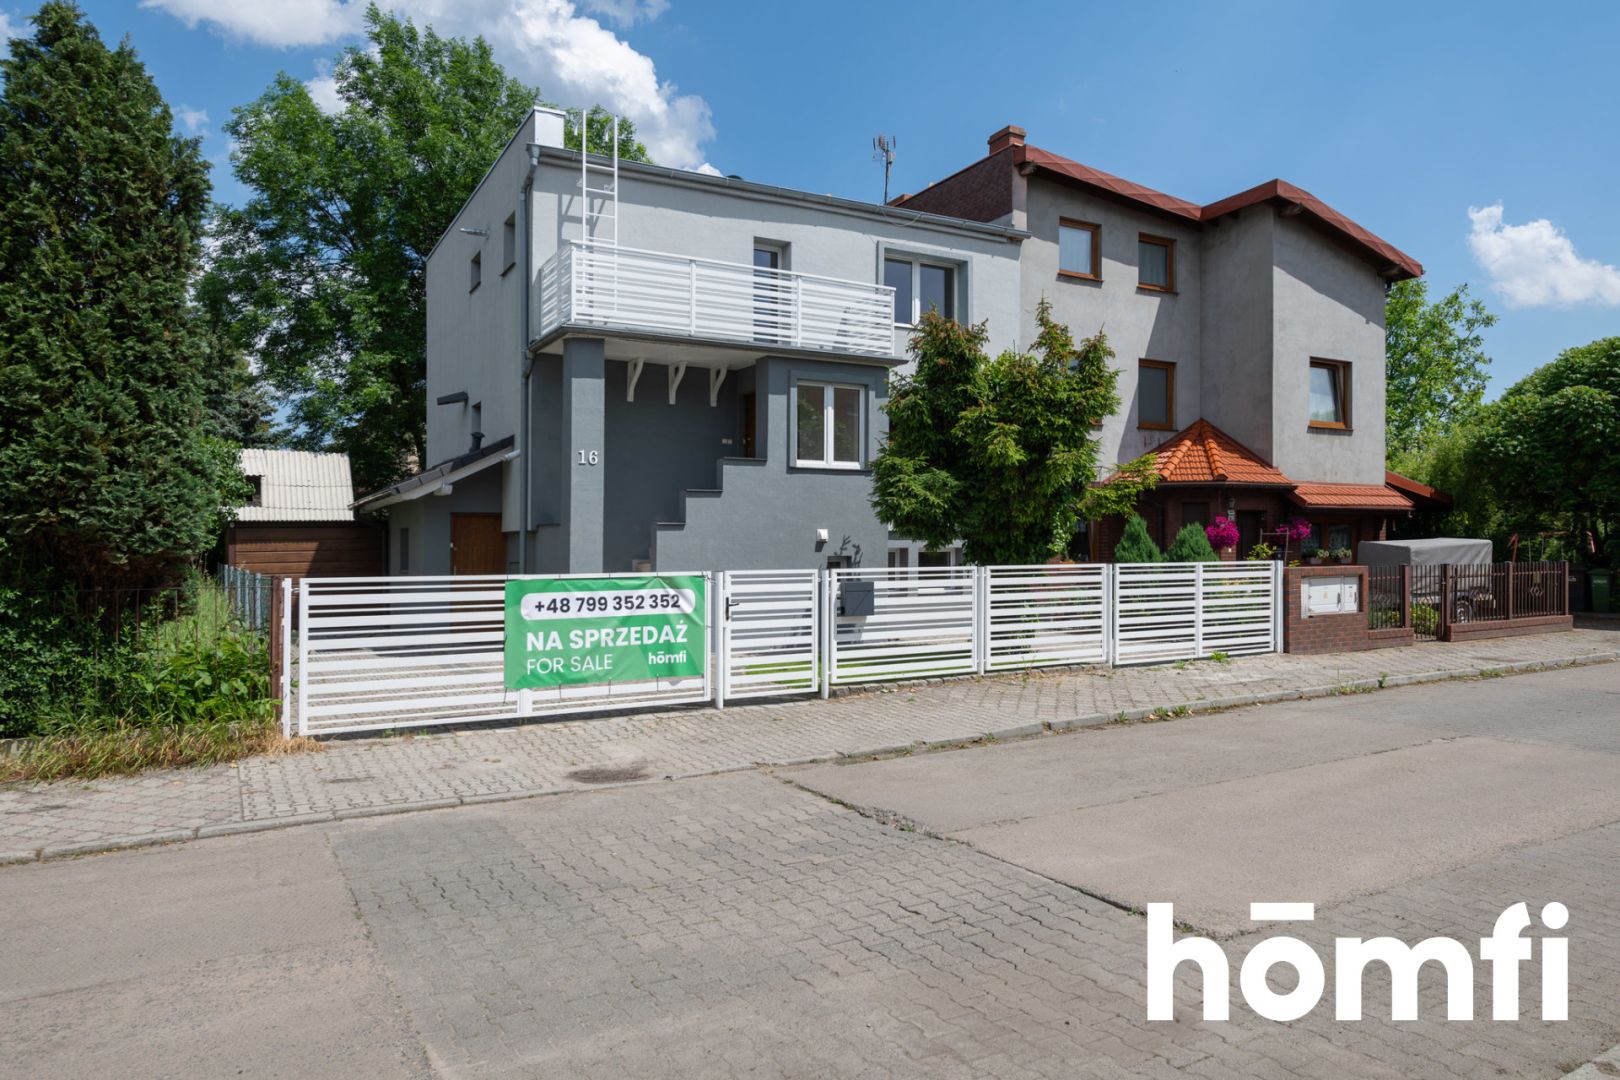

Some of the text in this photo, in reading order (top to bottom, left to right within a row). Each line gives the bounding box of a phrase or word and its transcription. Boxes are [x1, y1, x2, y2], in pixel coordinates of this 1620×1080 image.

[578, 449, 598, 465] 16
[535, 594, 681, 613] +48 799 352 352
[526, 620, 689, 651] NA SPRZEDAŻ
[526, 654, 613, 675] FOR SALE
